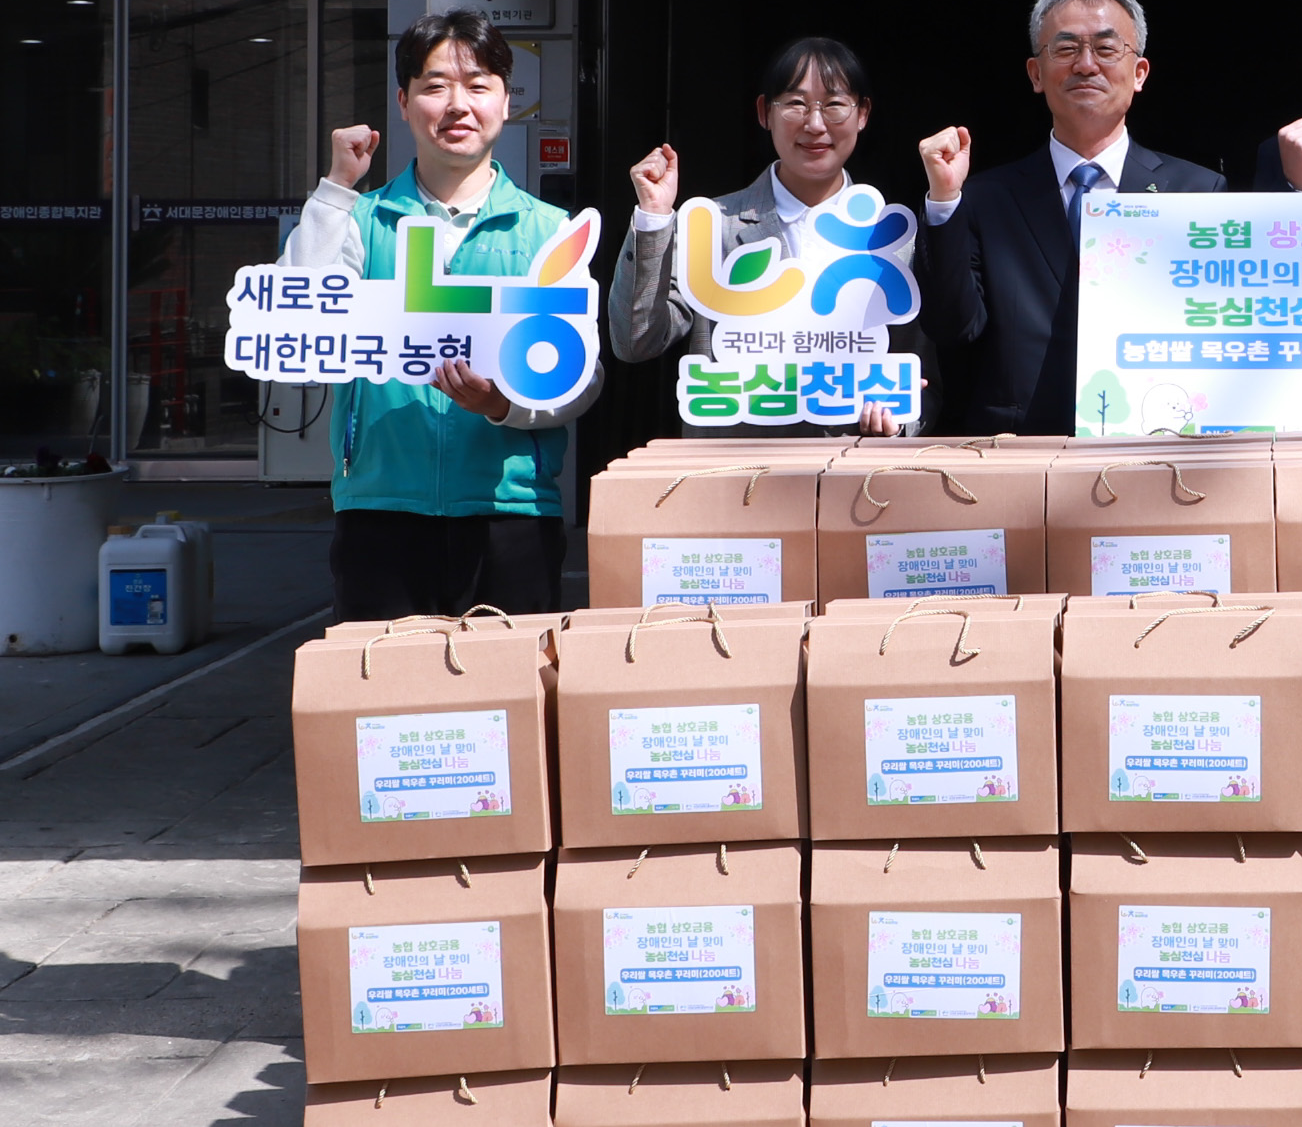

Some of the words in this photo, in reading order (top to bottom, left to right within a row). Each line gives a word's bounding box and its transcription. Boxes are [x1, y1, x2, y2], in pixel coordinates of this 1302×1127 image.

[492, 9, 532, 21] 협력기관
[1186, 220, 1252, 249] 농협
[1169, 258, 1300, 288] 장애인의
[237, 274, 354, 315] 새로운
[722, 331, 786, 355] 국민과
[792, 331, 877, 355] 함께하는
[235, 334, 388, 375] 대한민국
[1122, 340, 1194, 362] 농협쌀
[1200, 340, 1270, 362] 목우촌
[687, 361, 912, 418] 농심천심
[681, 554, 700, 563] 농협
[672, 566, 714, 577] 장애인의
[719, 566, 729, 577] 날
[733, 566, 752, 577] 맞이
[680, 579, 720, 589] 농심천심
[723, 578, 745, 590] 나눔
[652, 723, 672, 734] 농협
[643, 736, 688, 749] 장애인의
[693, 735, 704, 747] 날
[709, 735, 729, 746] 맞이
[651, 750, 695, 762] 농심천심
[697, 749, 721, 761] 나눔
[628, 771, 652, 780] 우리쌀
[654, 770, 678, 779] 목우촌
[681, 767, 747, 778] 꾸러미(200세트)
[1161, 922, 1181, 932] 농협
[392, 940, 412, 951] 농협
[1151, 935, 1197, 948] 장애인의
[1202, 936, 1213, 948] 날
[1218, 937, 1238, 948] 맞이
[382, 953, 428, 967] 장애인의
[433, 953, 444, 965] 날
[449, 952, 469, 964] 맞이
[1159, 950, 1203, 961] 농심천심
[1206, 950, 1230, 963] 나눔
[391, 967, 435, 980] 농심천심
[437, 966, 462, 979] 나눔
[1135, 968, 1159, 978] 우리쌀
[1162, 969, 1186, 978] 목우촌
[1189, 969, 1255, 979] 꾸러미(200세트)
[368, 988, 392, 998] 우리쌀
[394, 987, 419, 997] 목우촌
[422, 984, 487, 996] 꾸러미(200세트)
